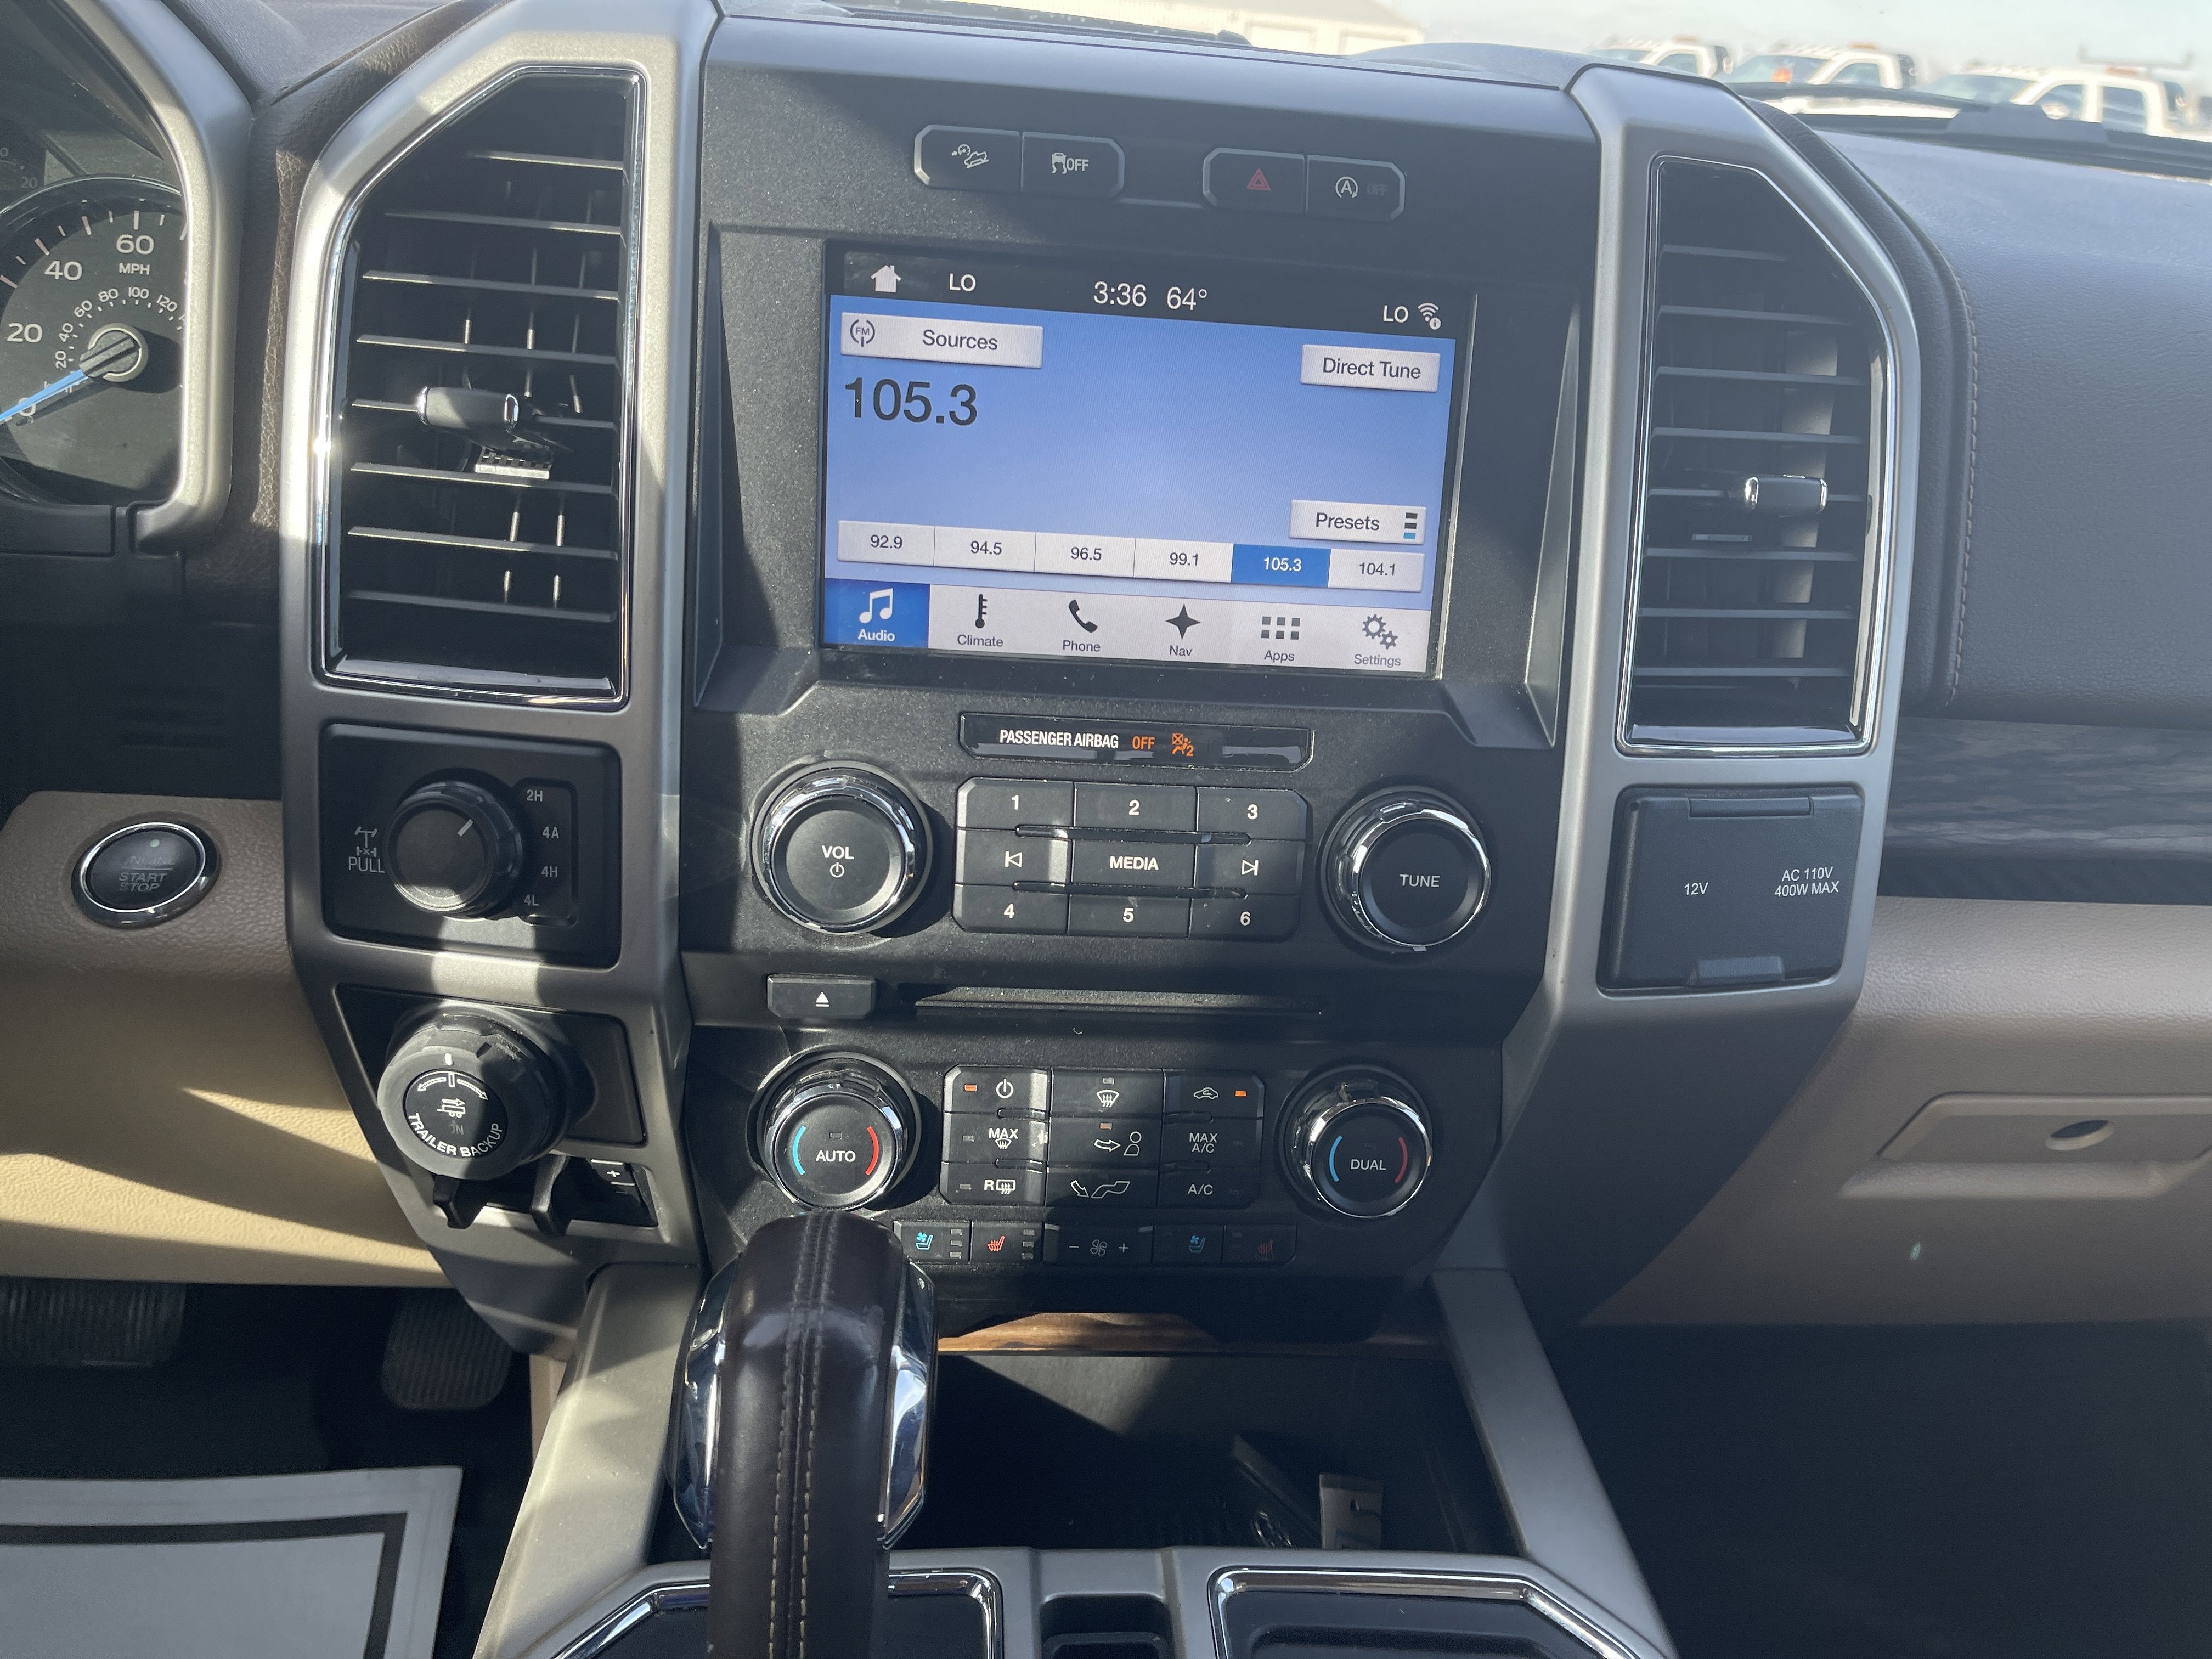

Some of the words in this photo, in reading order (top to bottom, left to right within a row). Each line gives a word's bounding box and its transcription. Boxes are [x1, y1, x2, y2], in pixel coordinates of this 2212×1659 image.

[1066, 158, 1089, 172] OFF
[21, 176, 37, 189] 20
[1340, 180, 1353, 194] A
[116, 234, 154, 255] 60
[44, 260, 82, 281] 40
[119, 262, 150, 276] MPH
[949, 273, 976, 292] LO
[98, 288, 119, 302] 80
[128, 286, 149, 300] 100
[1093, 281, 1147, 307] 3:36
[1166, 286, 1207, 311] 64°
[74, 300, 92, 318] 60
[156, 294, 178, 312] 120
[1383, 304, 1409, 323] LO
[7, 322, 42, 343] 20
[59, 322, 74, 343] 40
[856, 326, 870, 335] FM
[922, 329, 998, 351] Sources
[55, 351, 67, 369] 20
[1322, 357, 1375, 377] Direct
[1379, 360, 1421, 379] Tune
[845, 377, 978, 426] 105.3
[1315, 512, 1380, 532] Presets
[870, 535, 903, 549] 92.9
[970, 541, 1002, 556] 94.5
[1070, 547, 1102, 561] 96.5
[1169, 552, 1199, 567] 99.1
[1263, 557, 1302, 572] 105.3
[1358, 562, 1396, 577] 104.1
[857, 628, 895, 642] Audio
[957, 634, 1003, 648] Climate
[1062, 640, 1101, 652] Phone
[1169, 645, 1193, 657] Nav
[1263, 650, 1295, 663] Apps
[1353, 653, 1401, 668] Settings
[1000, 729, 1072, 747] PASSENGER
[1074, 731, 1119, 749] AIRBAG
[1132, 736, 1155, 751] OFF
[526, 789, 543, 802] 2H
[1012, 795, 1020, 810] 1
[1128, 800, 1140, 816] 2
[1246, 804, 1258, 820] 3
[542, 826, 559, 839] 4A
[822, 845, 855, 860] VOL
[348, 856, 385, 874] PULL
[1109, 856, 1159, 871] MEDIA
[119, 872, 168, 883] START
[541, 865, 558, 878] 4H
[1782, 868, 1800, 882] AC
[1804, 866, 1833, 880] 110V
[119, 882, 160, 892] STOP
[1400, 874, 1440, 888] TUNE
[1684, 882, 1709, 896] 12V
[1774, 883, 1809, 898] 400W
[1811, 881, 1839, 894] MAX
[523, 895, 539, 907] 4L
[1003, 904, 1015, 919] 4
[1122, 908, 1134, 923] 5
[1240, 911, 1251, 926] 6
[408, 1113, 457, 1156] TRAILER
[459, 1123, 503, 1157] BACKUP
[988, 1128, 1019, 1139] MAX
[1189, 1132, 1218, 1143] MAX
[1192, 1143, 1215, 1154] A/C
[815, 1150, 856, 1163] AUTO
[1350, 1159, 1387, 1171] DUAL
[984, 1180, 994, 1191] R
[1187, 1184, 1214, 1195] A/C
